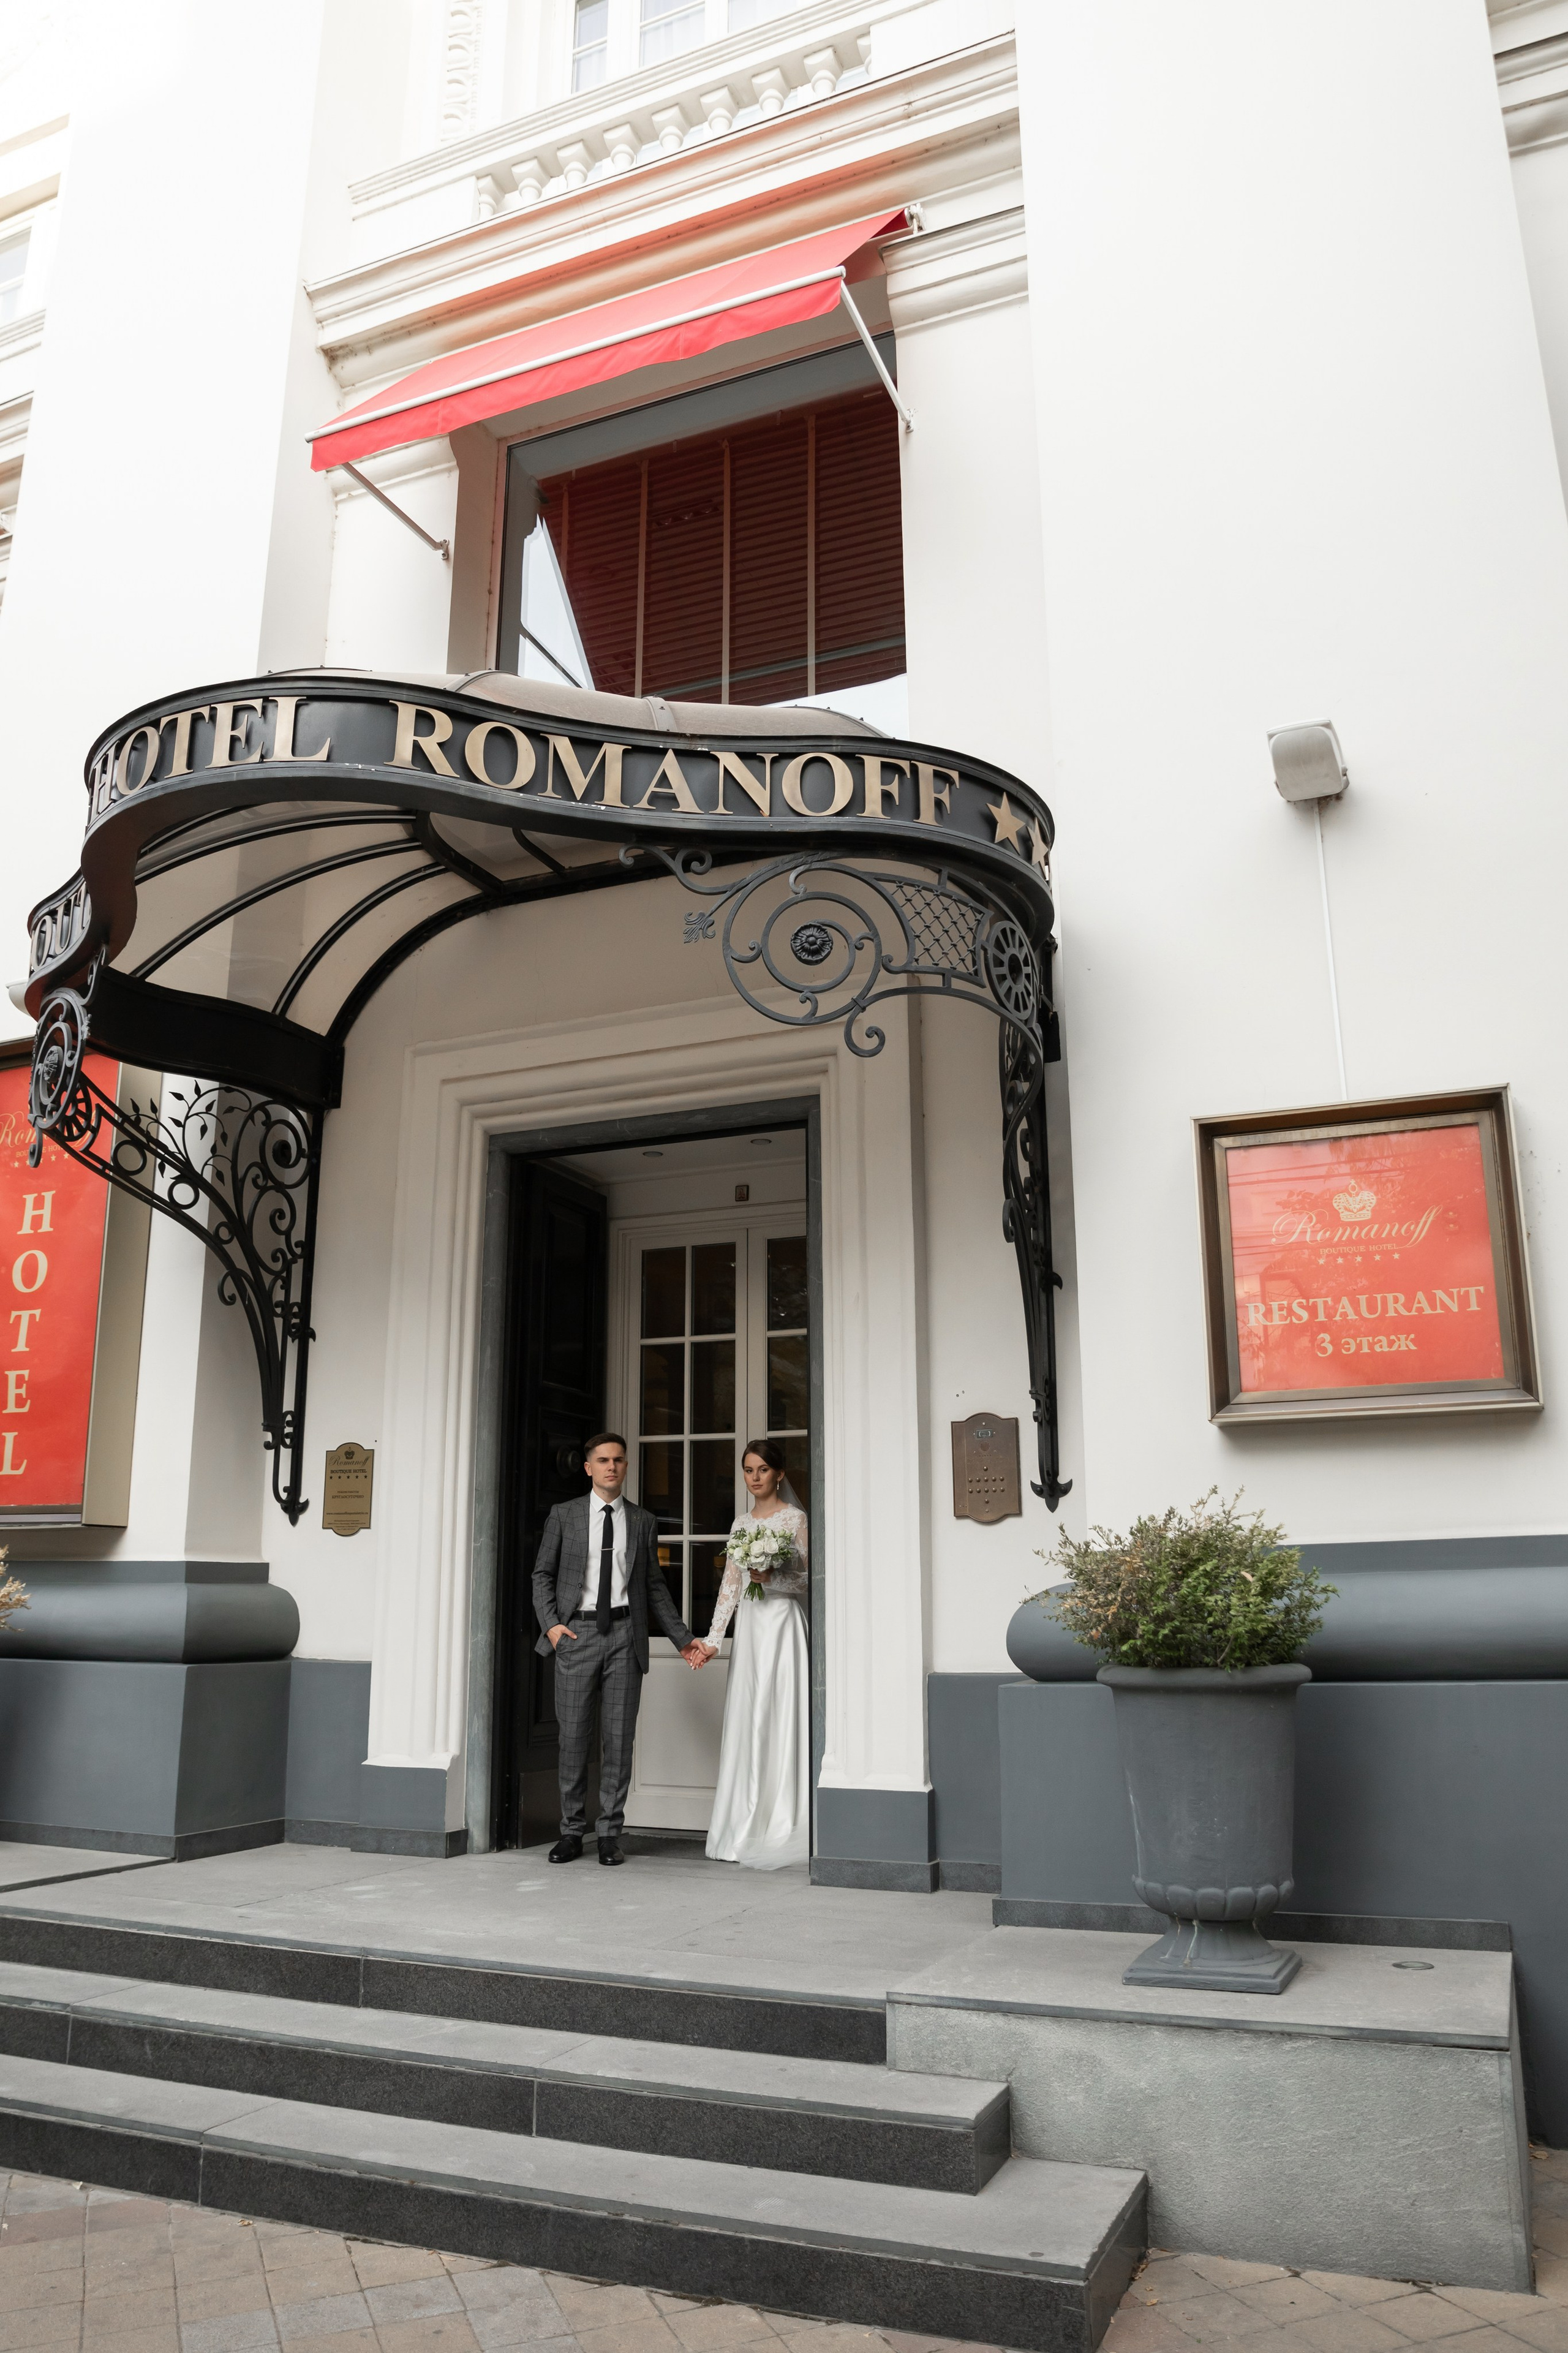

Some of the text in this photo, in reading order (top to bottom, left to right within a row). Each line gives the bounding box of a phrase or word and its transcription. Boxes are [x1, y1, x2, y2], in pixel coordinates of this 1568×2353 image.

[89, 697, 331, 826] HOTEL
[383, 700, 959, 827] ROMANOFF
[1271, 1204, 1443, 1246] Romanoff
[1319, 1243, 1399, 1255] BOUTIQUE HOTEL
[1245, 1286, 1485, 1327] RESTAURANT
[0, 1190, 56, 1476] HOTEL
[1316, 1332, 1417, 1357] 3 этаж
[328, 1454, 370, 1467] Romanoff
